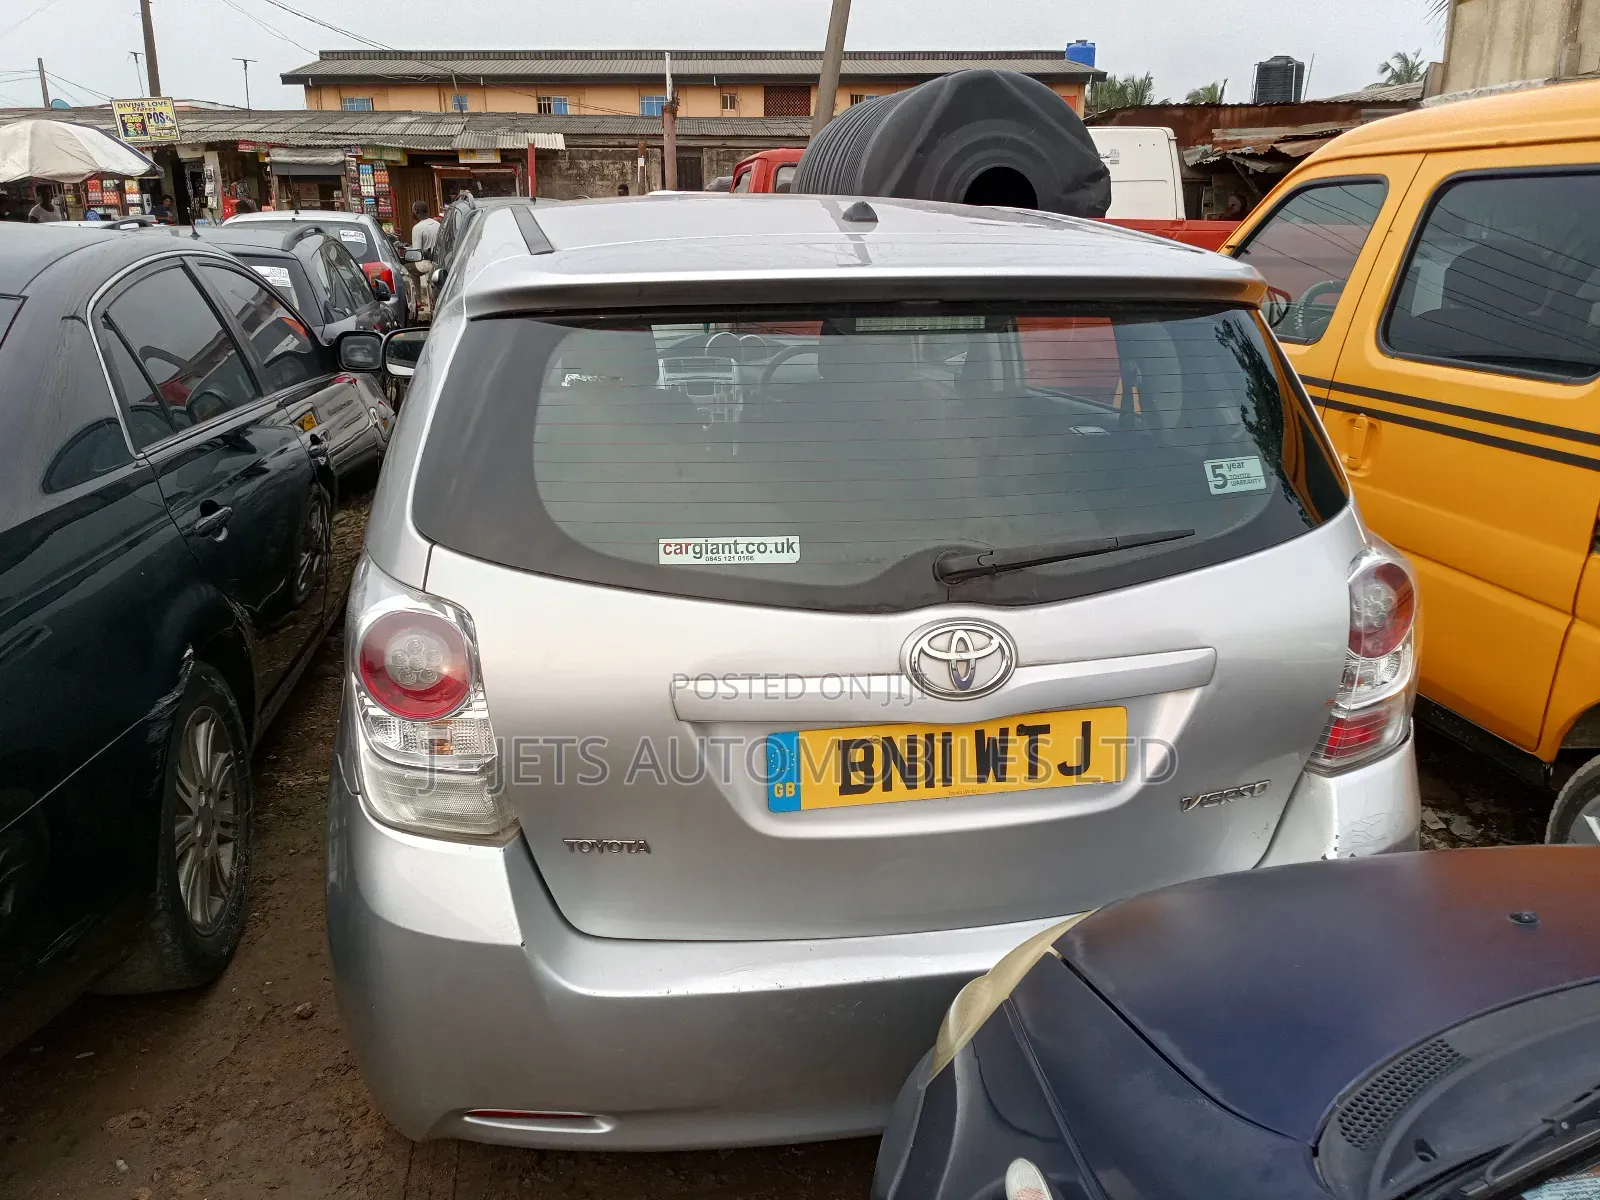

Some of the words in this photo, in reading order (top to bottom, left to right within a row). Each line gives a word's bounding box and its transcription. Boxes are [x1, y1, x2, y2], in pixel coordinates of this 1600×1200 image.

[117, 101, 145, 109] DIVINE
[146, 111, 166, 124] POS
[1211, 463, 1228, 490] 5
[1226, 461, 1245, 471] year
[662, 538, 796, 559] cargiant.co.uk
[773, 781, 796, 798] GB
[562, 838, 652, 855] TOYOTA
